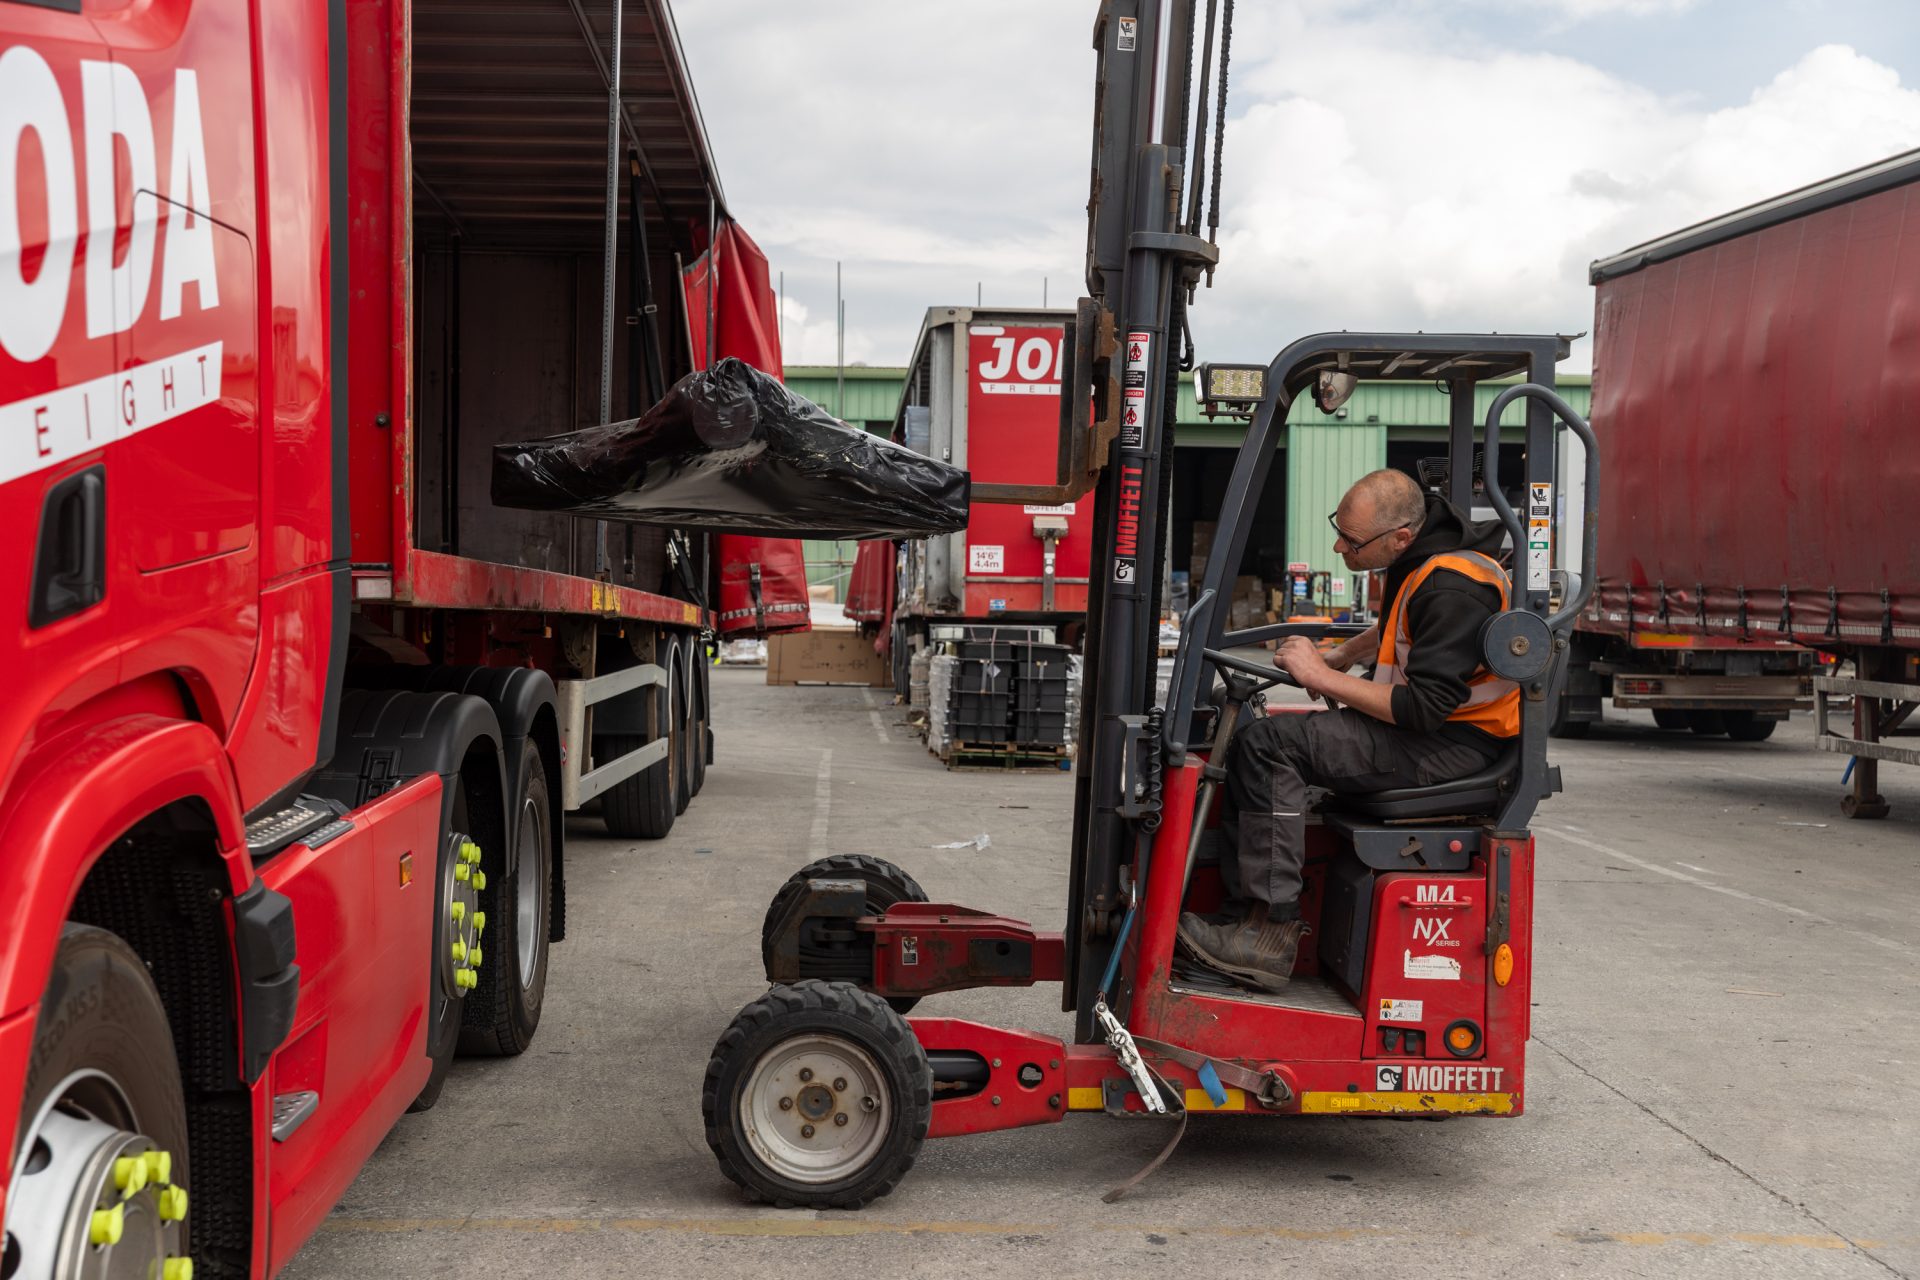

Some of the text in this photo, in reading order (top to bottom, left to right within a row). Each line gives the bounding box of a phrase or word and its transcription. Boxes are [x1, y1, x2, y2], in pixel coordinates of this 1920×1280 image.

[978, 337, 1064, 381] JO
[1116, 464, 1143, 555] MOFFETT
[1416, 885, 1456, 910] M4
[1412, 917, 1453, 947] NX
[1407, 1066, 1504, 1091] MOFFETT
